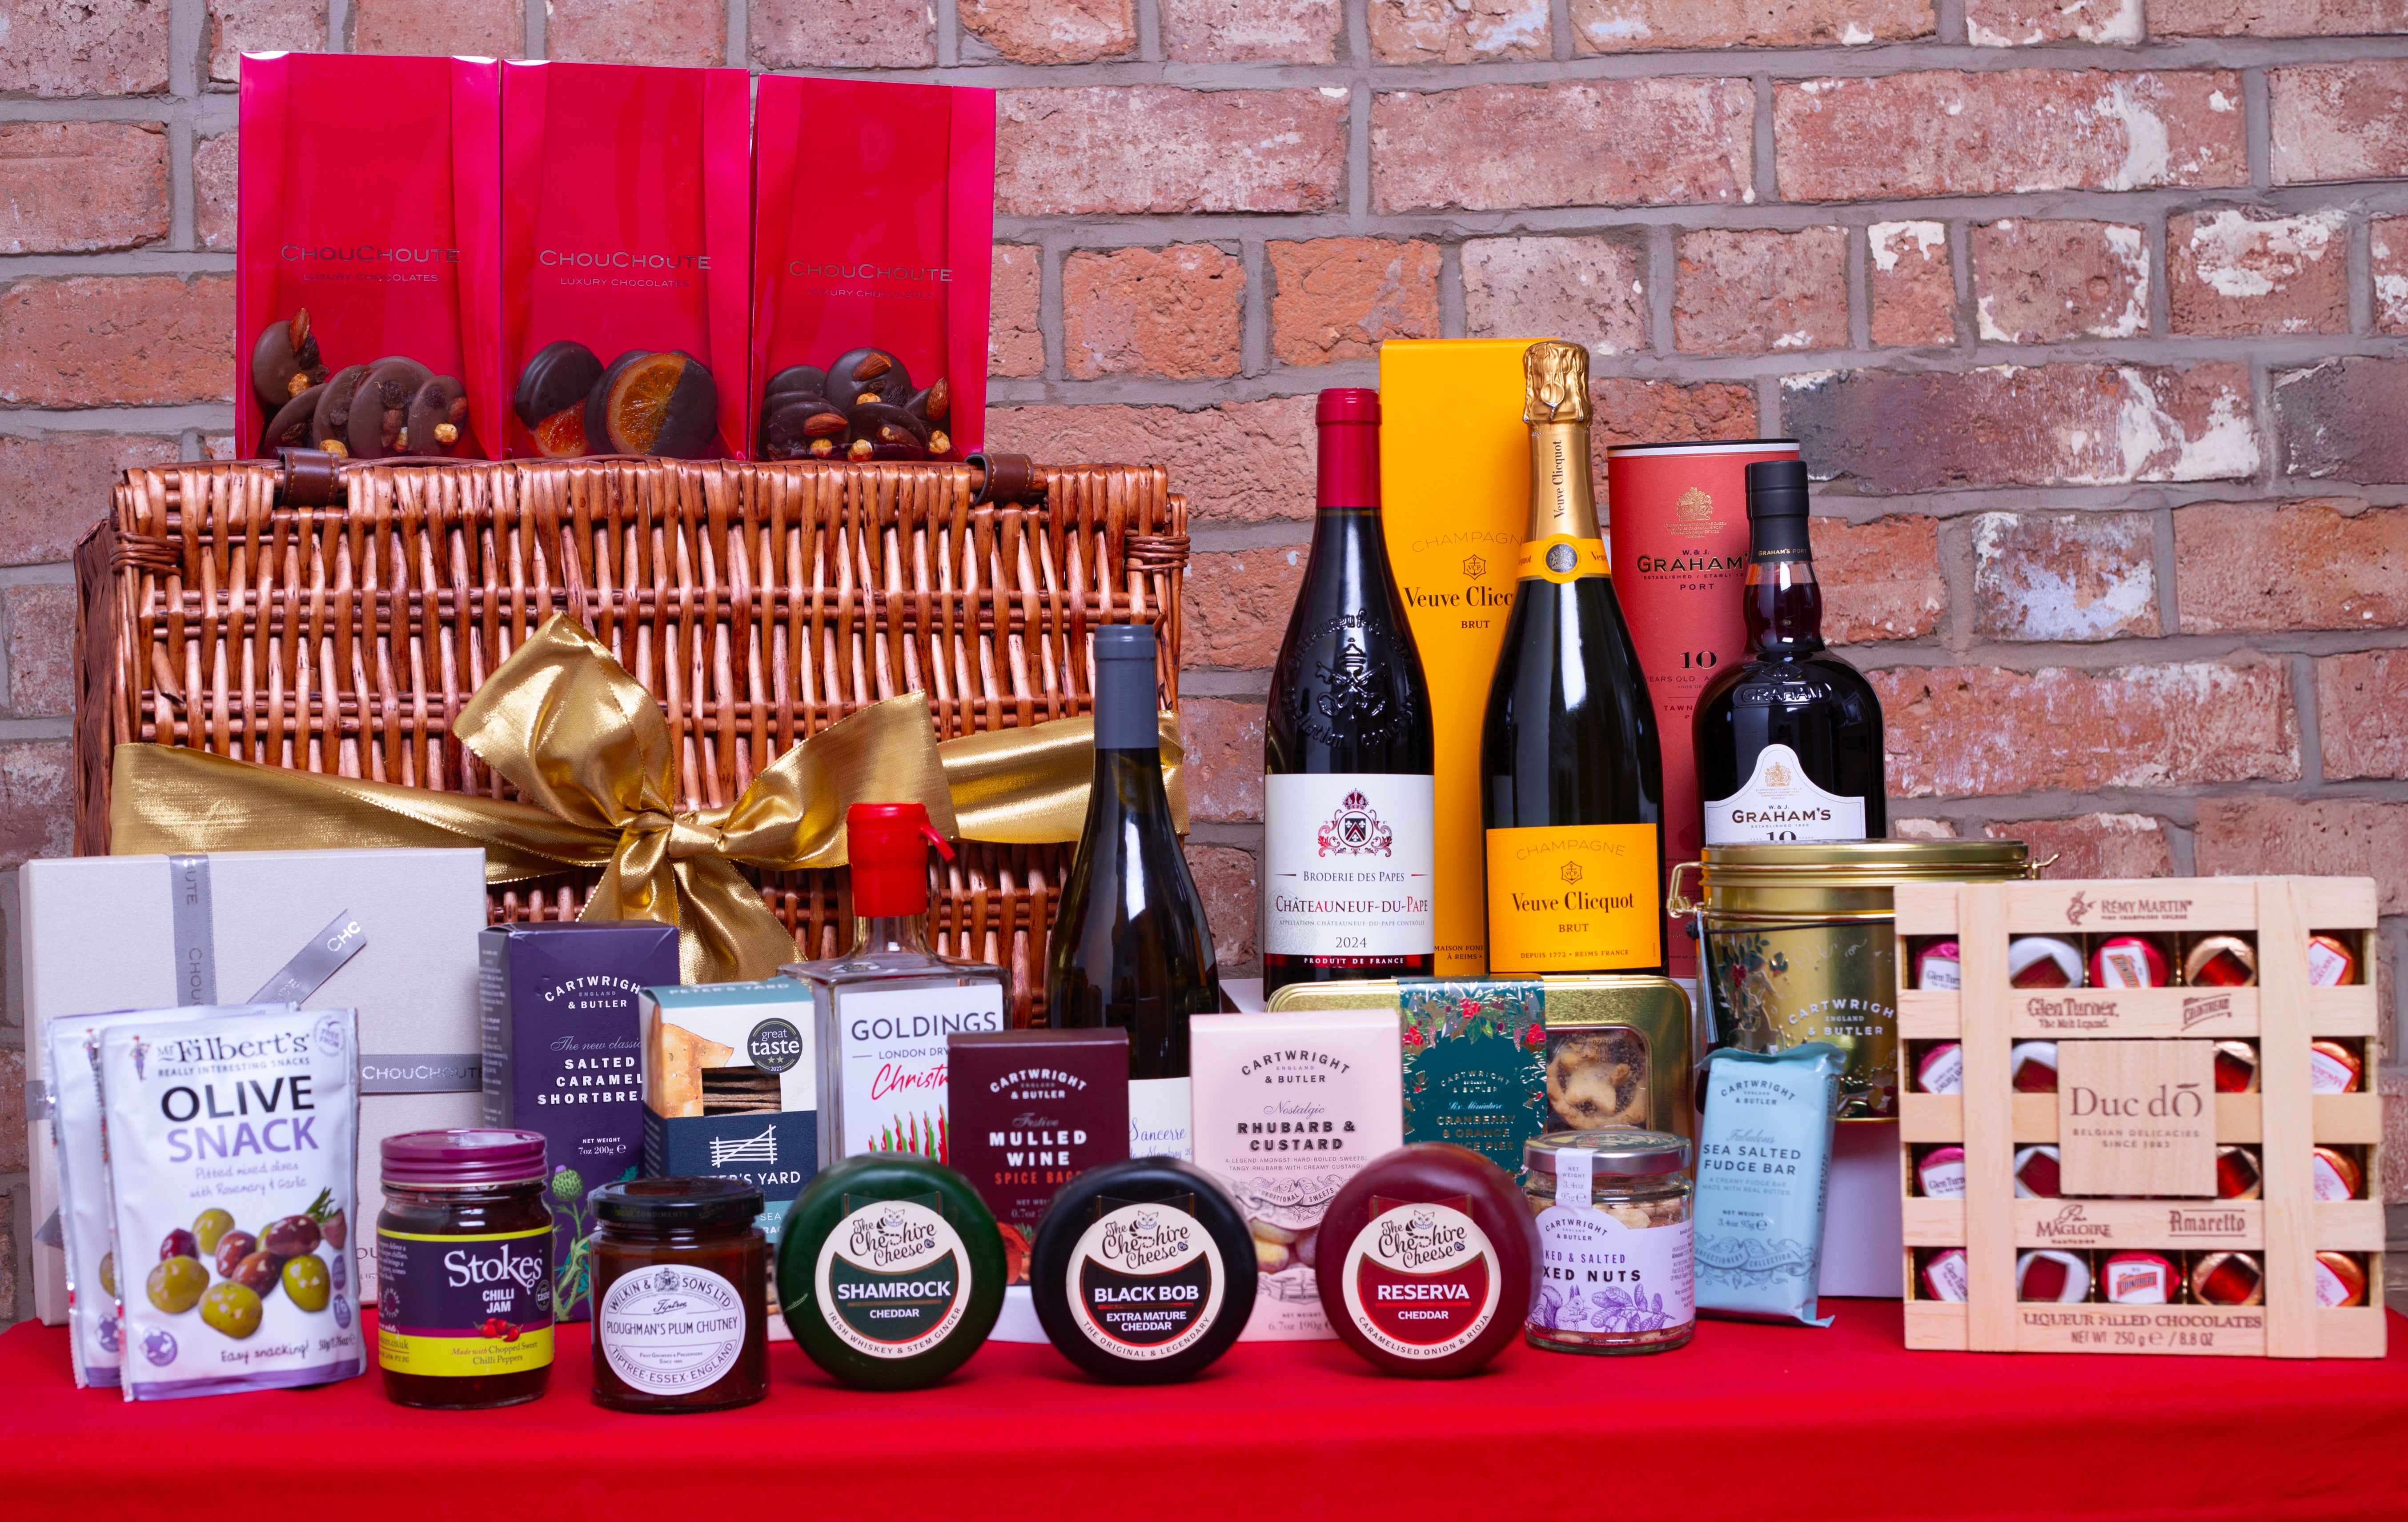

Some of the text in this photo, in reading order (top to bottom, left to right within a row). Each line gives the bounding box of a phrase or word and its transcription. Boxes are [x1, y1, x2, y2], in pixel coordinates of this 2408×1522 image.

[561, 277, 690, 288] LUXURY CHOCOLATES
[807, 288, 932, 300] LUXURY CHOCOLATES
[1552, 439, 1565, 520] Veuve Clicquot
[1412, 531, 1524, 553] CHAMPAGN
[1637, 552, 1749, 573] GRAHAM'
[1403, 585, 1513, 608] Veuve Clic
[1461, 621, 1490, 629] BRUT
[1680, 650, 1718, 670] 10
[1741, 686, 1822, 703] GRAHAM
[1516, 839, 1626, 861] CHAMPAGNE
[1357, 873, 1376, 882] DES
[1511, 891, 1635, 913] Veuve Clicquot
[2101, 899, 2135, 914] RÉMY
[1558, 923, 1589, 933] BRUT
[1335, 937, 1368, 949] 2024
[544, 975, 642, 1002] CARTWRIGH
[581, 999, 627, 1009] BUTLER
[1787, 998, 1896, 1025] CARTWRIGH
[851, 1011, 997, 1041] GOLDINGS
[1824, 1026, 1884, 1036] BUTLER
[761, 1029, 788, 1041] great
[173, 1033, 309, 1065] Filbert's
[750, 1039, 800, 1055] taste
[879, 1049, 926, 1060] LONDON
[157, 1061, 268, 1078] REALLY INTERESTING
[564, 1056, 635, 1070] SALTED
[1241, 1049, 1350, 1076] CARTWRIGHT
[556, 1073, 643, 1088] CARAMEL
[990, 1068, 1088, 1093] CARTWRIGHT
[1278, 1074, 1326, 1083] BUTLER
[1441, 1070, 1510, 1087] CARTWRIGHT
[1022, 1090, 1066, 1099] BUTLER
[1721, 1079, 1796, 1101] CARTWRIGHT
[161, 1075, 315, 1122] OLIVE
[1743, 1097, 1778, 1105] BUTLER
[2070, 1086, 2139, 1117] Duc
[1263, 1101, 1325, 1120] Nostalgic
[1236, 1121, 1333, 1135] RHUBARB
[1436, 1115, 1516, 1125] CRANBERRY
[1130, 1117, 1187, 1142] Sancerre
[1455, 1128, 1510, 1138] ORANGE
[2072, 1128, 2199, 1138] BELGIAN DELICACIES
[166, 1115, 319, 1164] SNACK
[989, 1130, 1088, 1147] MULLED
[1248, 1137, 1343, 1153] CUSTARD
[1486, 1141, 1513, 1151] PIES
[2102, 1141, 2138, 1149] SINCE
[1007, 1151, 1070, 1167] WINE
[1702, 1144, 1802, 1161] SEA SALTED
[1704, 1159, 1797, 1176] FUDGE BAR
[758, 1170, 801, 1186] YARD
[995, 1171, 1038, 1185] SPICE
[1545, 1218, 1608, 1236] CARTWRIGHT
[2036, 1221, 2113, 1238] MAGLOIRE
[2169, 1210, 2246, 1233] Amaretto
[1581, 1254, 1625, 1264] SALTED
[444, 1244, 543, 1296] Stokes
[1587, 1270, 1641, 1282] NUTS
[482, 1288, 514, 1302] CHILLI
[610, 1281, 641, 1311] WILKIN
[682, 1277, 713, 1294] SONS
[714, 1287, 731, 1308] LTD
[837, 1281, 951, 1300] SHAMROCK
[1094, 1285, 1199, 1303] BLACK BOB
[1377, 1284, 1470, 1300] RESERVA
[486, 1301, 511, 1314] JAM
[869, 1308, 920, 1319] CHEDDAR
[1398, 1310, 1449, 1320] CHEDDAR
[1106, 1311, 1187, 1322] EXTRA MATURE
[2023, 1313, 2262, 1329] LIQUEUR FILLED CHOCOLATES
[606, 1316, 738, 1335] PLOUGHMAN'S PLUM CHUTNEY
[828, 1306, 962, 1354] IRISH WHISKEY STEM GINGER
[1121, 1322, 1172, 1332] CHEDDAR
[1100, 1316, 1211, 1358] ORIGINAL LEGENDARY
[1358, 1314, 1489, 1356] CARAMELISED ONION RIOJA
[2071, 1332, 2214, 1346] NET WT 250 8.8 OZ
[488, 1342, 520, 1354] Chopped
[221, 1350, 249, 1365] Easy
[497, 1354, 523, 1365] Peppers
[612, 1342, 734, 1383] TIPTREE ESSEX ENGLAND
